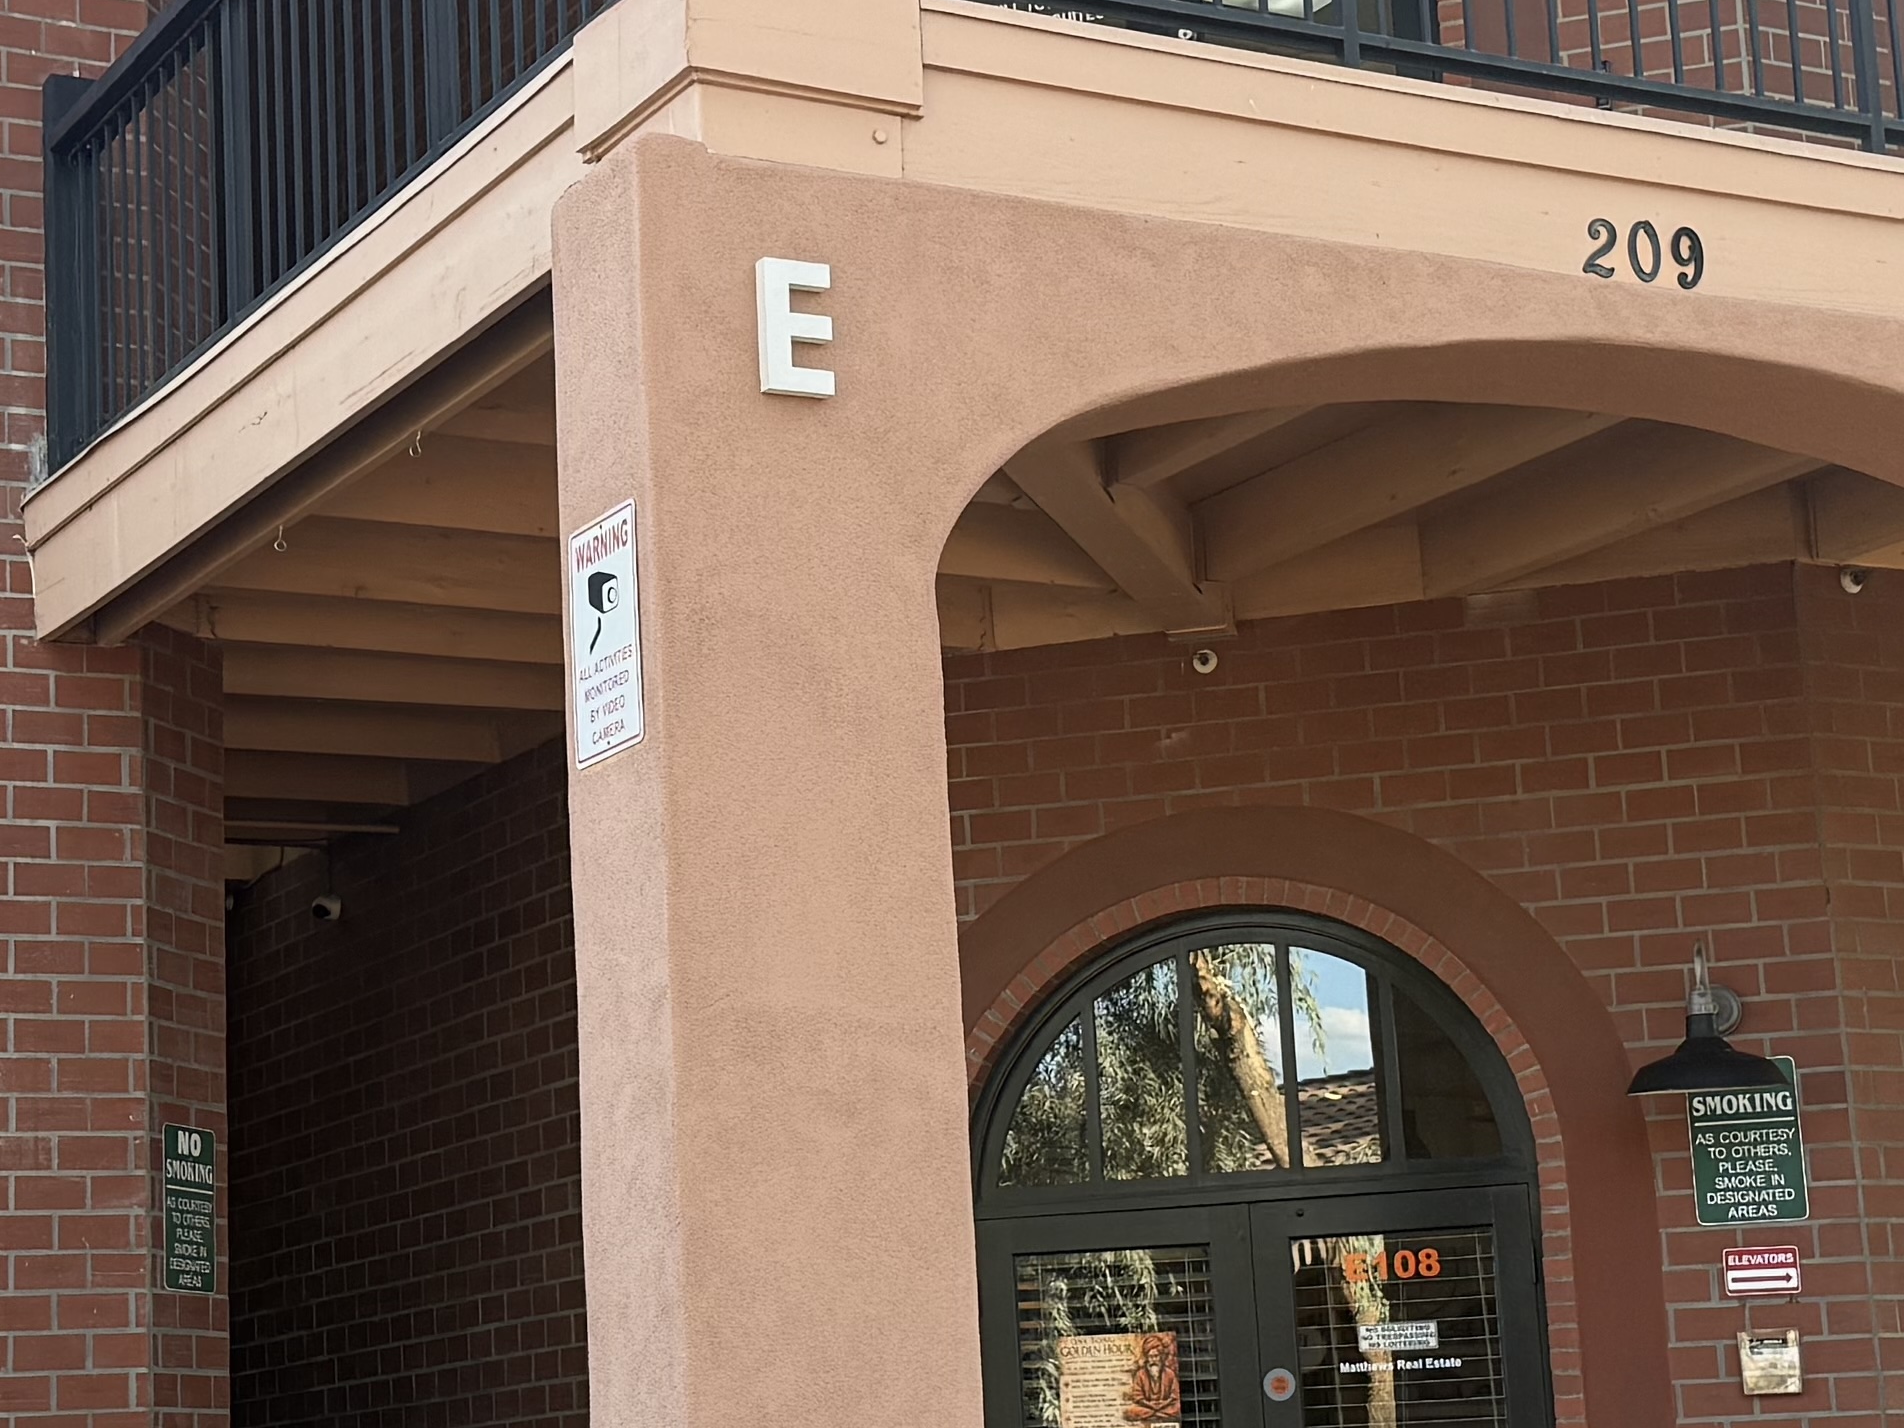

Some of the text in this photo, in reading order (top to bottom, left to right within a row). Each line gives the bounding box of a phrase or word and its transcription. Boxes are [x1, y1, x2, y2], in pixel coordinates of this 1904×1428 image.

[1582, 218, 1704, 289] 209
[755, 256, 835, 398] E
[575, 517, 629, 574] WARNING
[592, 719, 625, 745] CAMERA
[1692, 1091, 1793, 1116] SMOKING
[178, 1130, 201, 1157] NO
[1696, 1128, 1795, 1145] AS COURTESY
[1707, 1147, 1726, 1159] TO
[166, 1159, 213, 1184] SMOKING
[1715, 1174, 1785, 1189] SMOKE IN
[1707, 1188, 1795, 1204] DESIGNATED
[1728, 1204, 1777, 1218] AREAS
[1345, 1248, 1441, 1282] E108
[1727, 1252, 1794, 1266] ELEVATORS
[1397, 1359, 1423, 1370] Real
[1425, 1357, 1462, 1369] Estate
